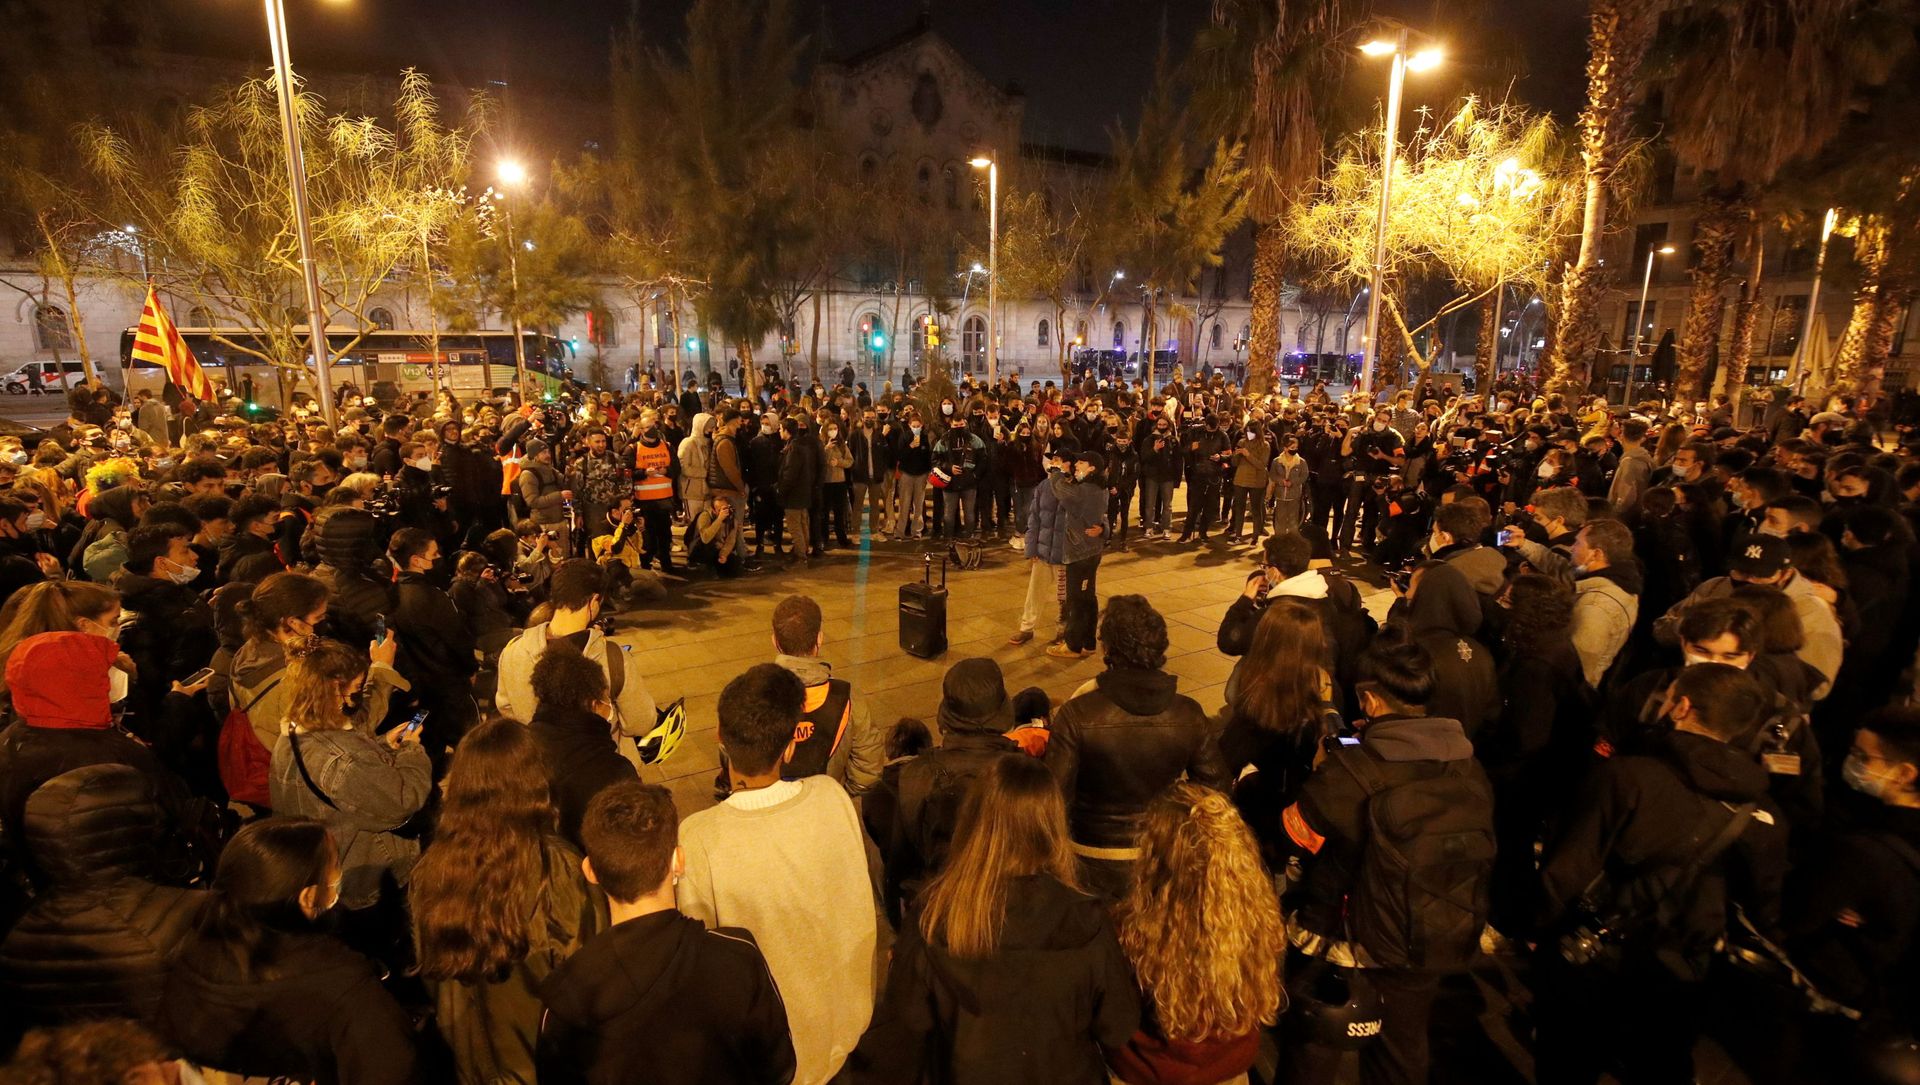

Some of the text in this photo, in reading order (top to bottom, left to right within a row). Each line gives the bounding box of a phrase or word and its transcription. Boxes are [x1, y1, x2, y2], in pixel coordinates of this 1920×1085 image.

[403, 367, 421, 376] V13
[426, 367, 444, 375] H2
[1743, 544, 1763, 559] NY
[1346, 1018, 1383, 1037] PRESS
